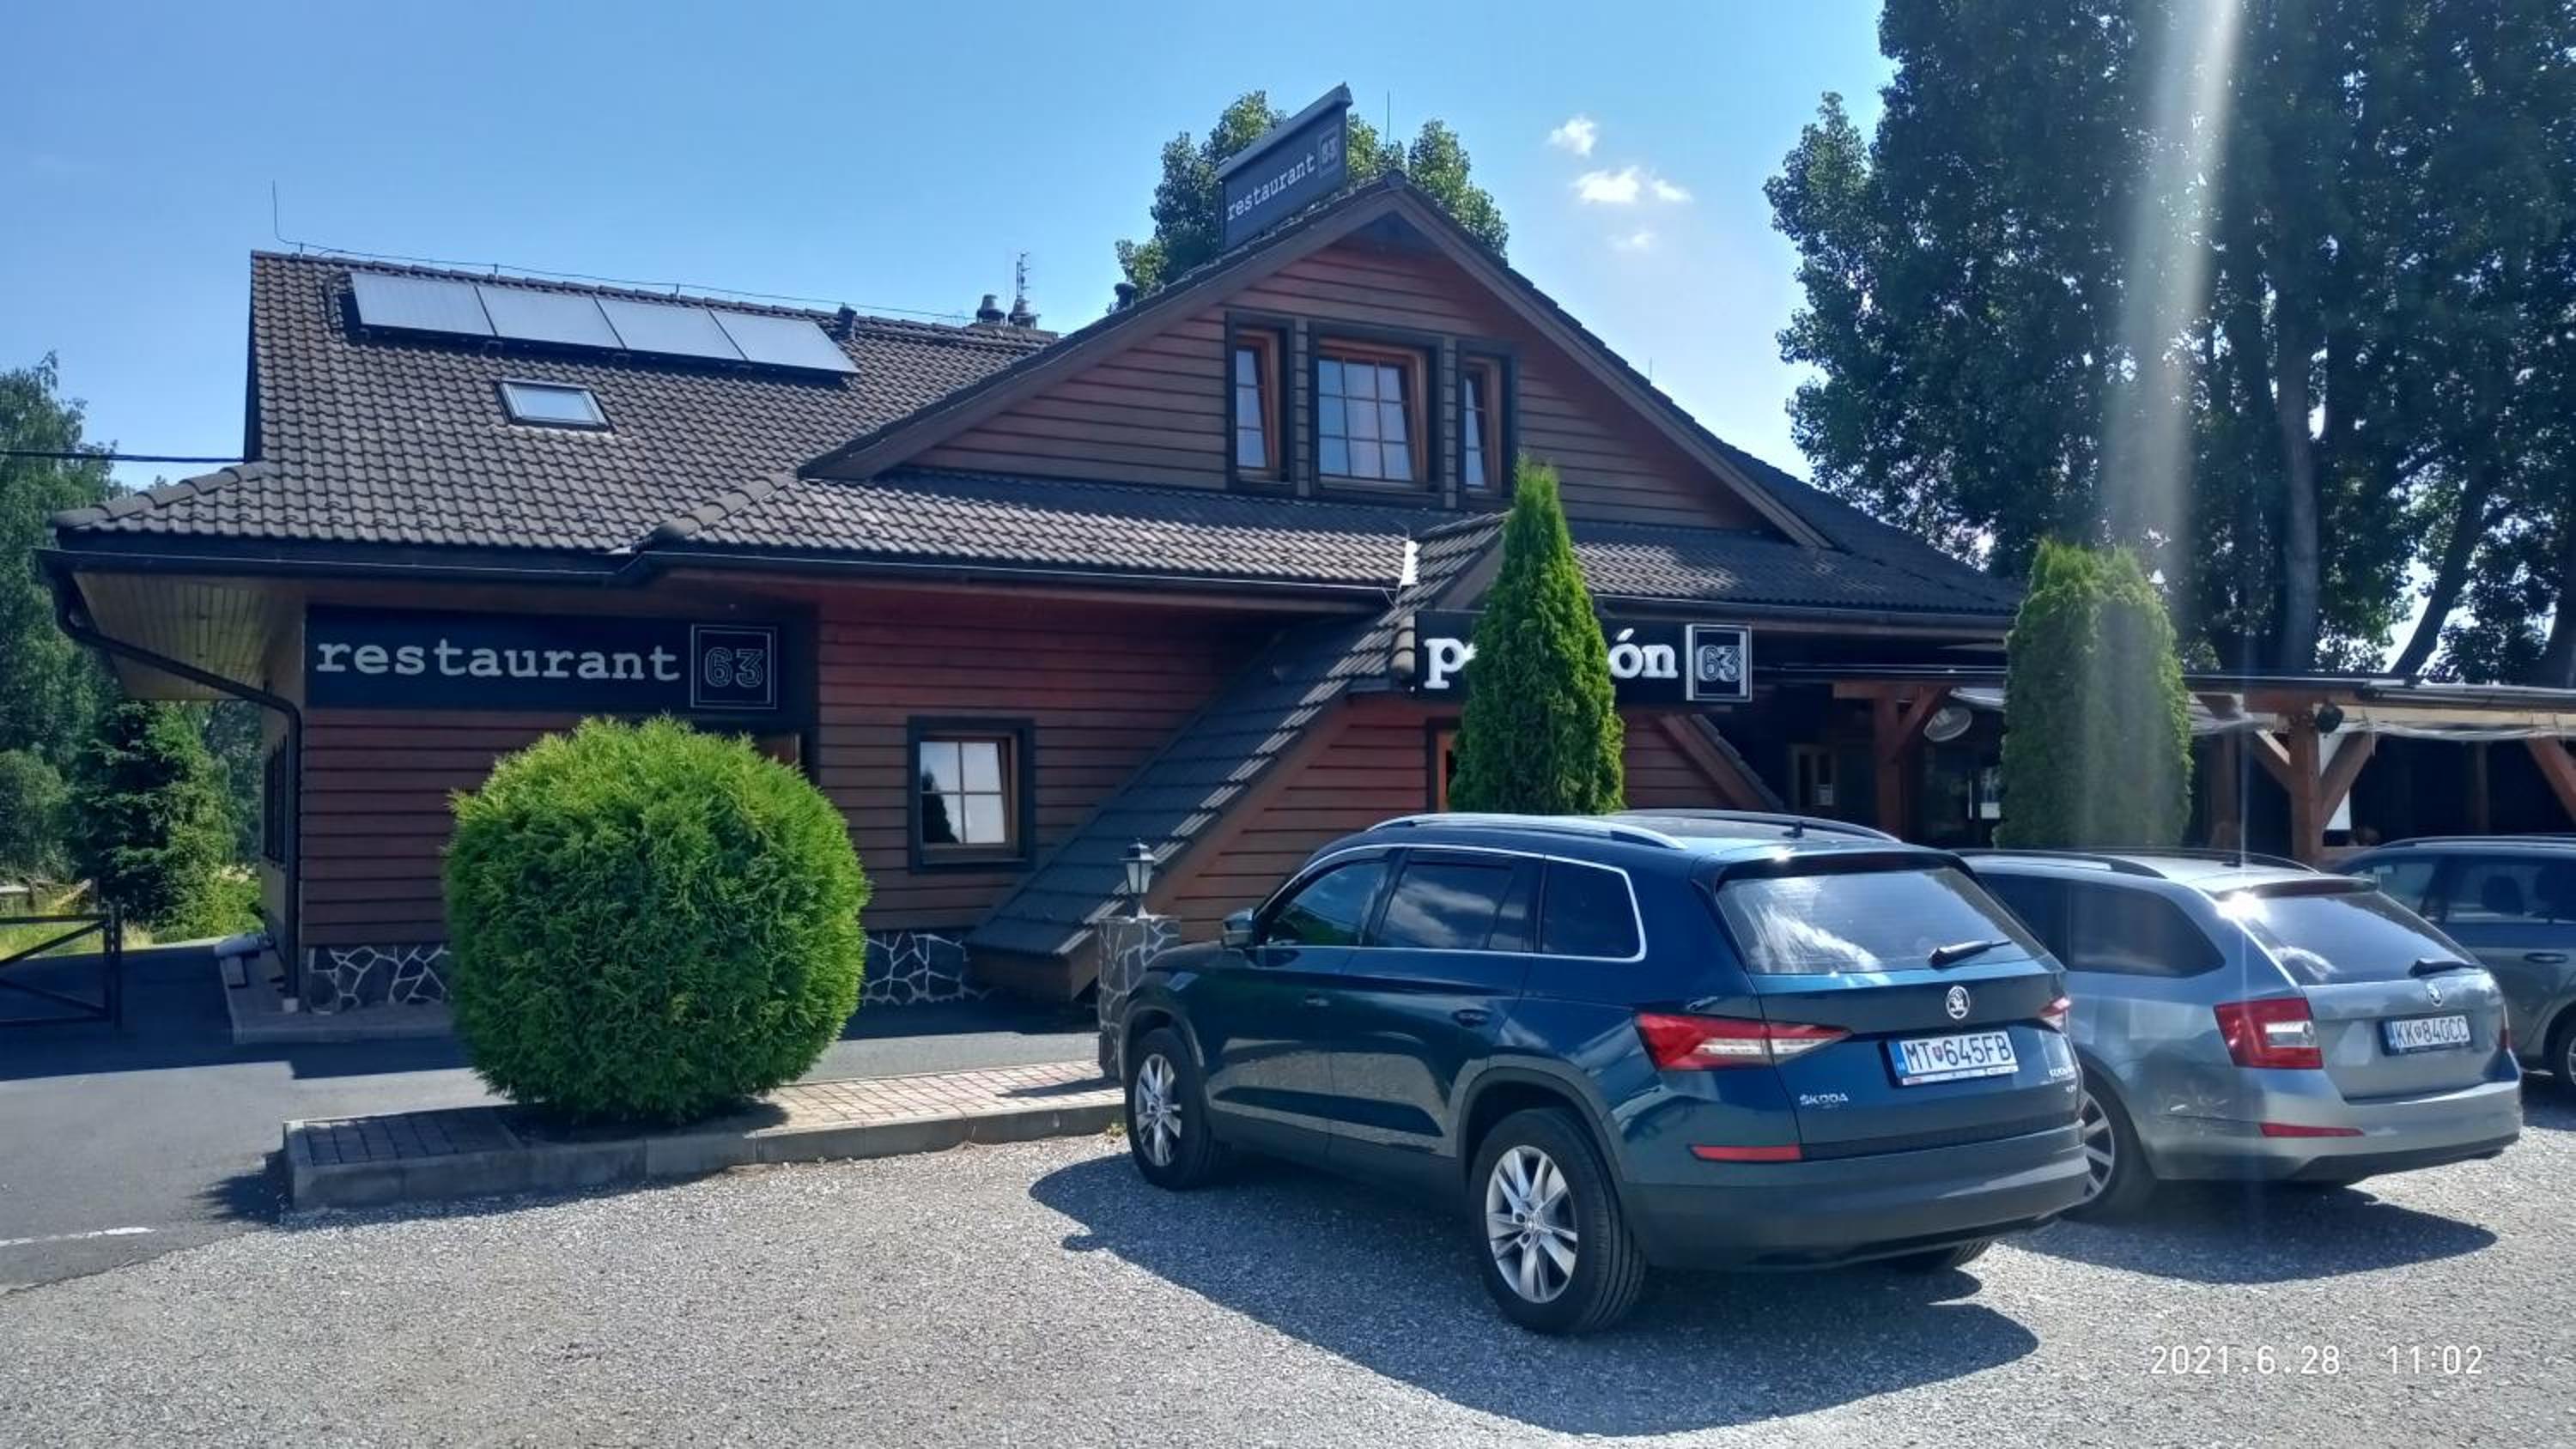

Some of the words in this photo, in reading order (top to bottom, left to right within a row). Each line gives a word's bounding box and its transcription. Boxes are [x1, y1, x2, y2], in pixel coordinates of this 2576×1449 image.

[1227, 153, 1315, 221] restaurant
[316, 639, 681, 682] restaurant
[704, 646, 763, 688] 63
[1696, 645, 1741, 682] 63
